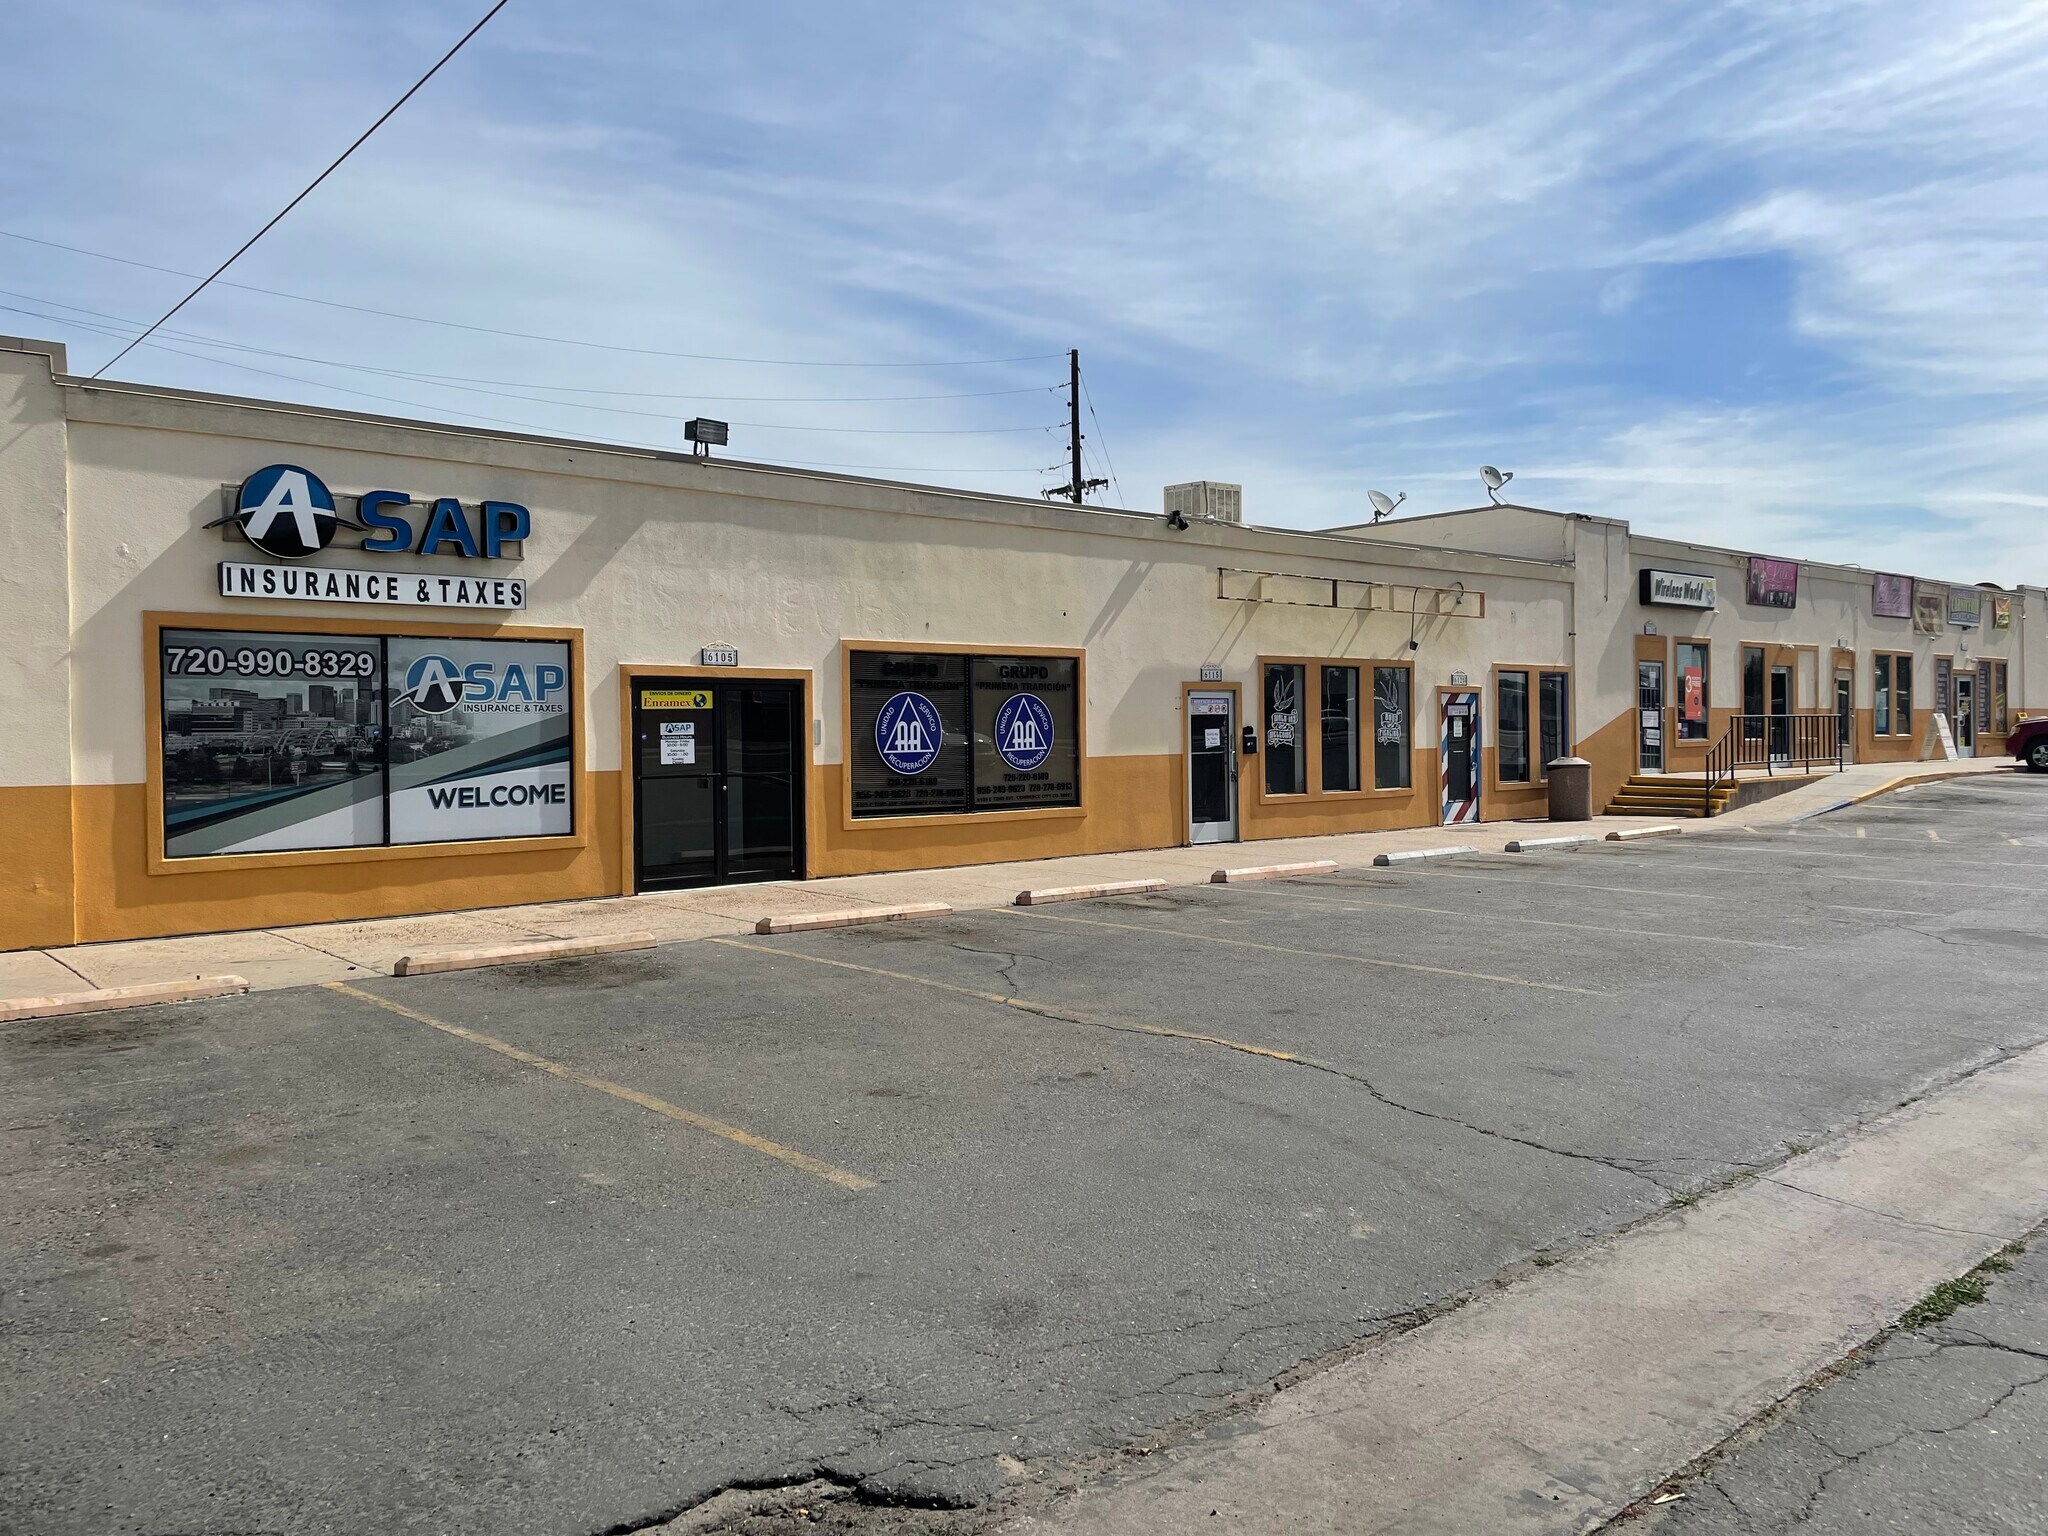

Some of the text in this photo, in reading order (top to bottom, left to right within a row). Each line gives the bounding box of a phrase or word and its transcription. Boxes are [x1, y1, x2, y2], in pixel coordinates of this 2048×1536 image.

[226, 566, 399, 601] INSURANCE
[1655, 577, 1704, 601] Wireless World
[167, 646, 376, 679] 720-990-8329
[707, 652, 734, 663] 6105
[881, 662, 939, 677] GRUPO
[999, 665, 1049, 679] GRUPO
[1204, 671, 1219, 679] 6115
[1685, 675, 1693, 693] 3
[463, 703, 564, 713] INSURANCE & TAXES
[643, 697, 691, 708] Enramex
[880, 706, 895, 735] UNIDAD
[918, 702, 937, 732] SERVICIO
[1000, 707, 1012, 735] UNIDAD
[1032, 703, 1049, 731] SERVICIO
[427, 783, 566, 810] WELCOME
